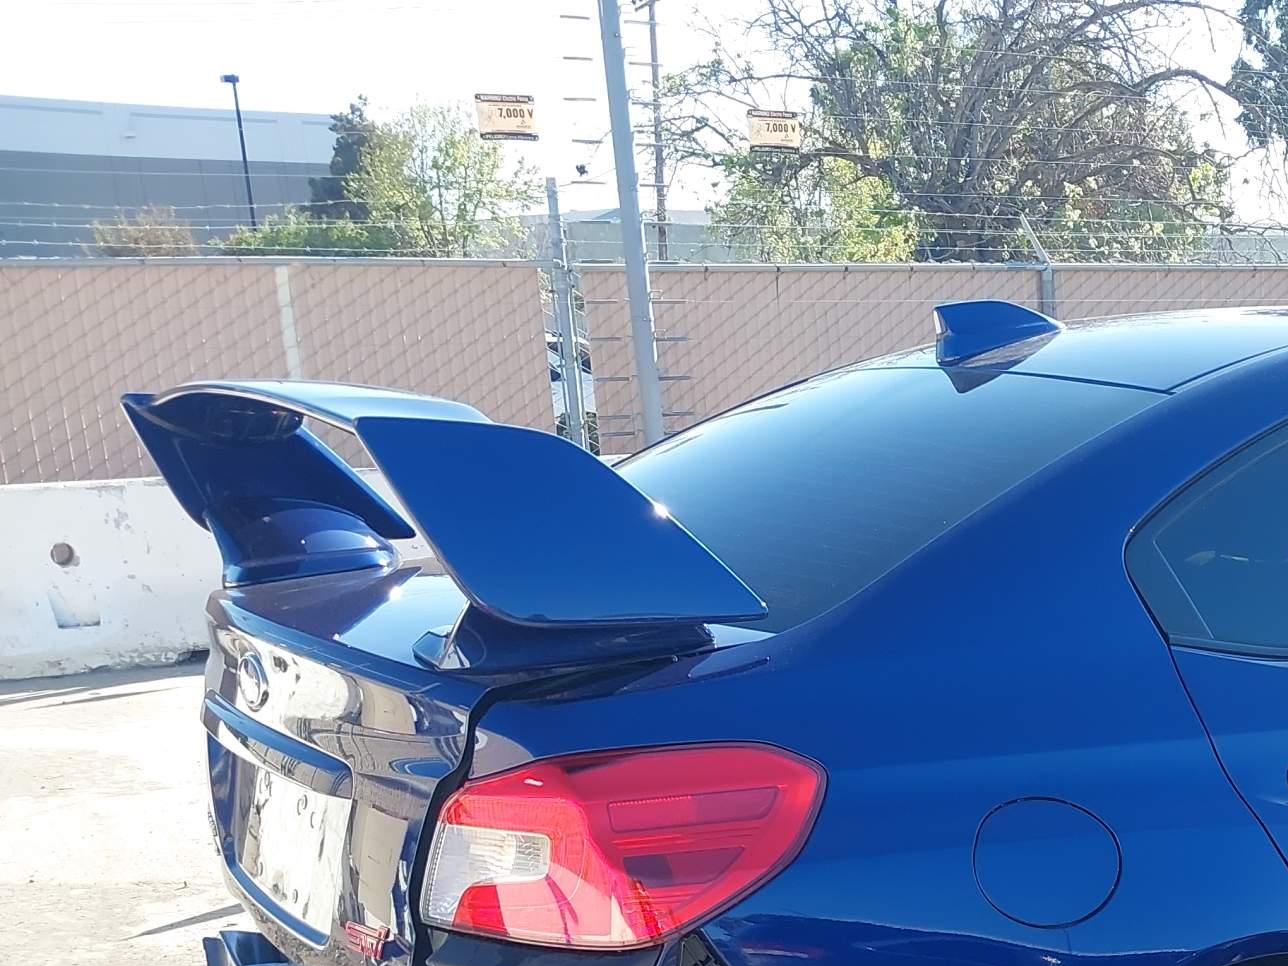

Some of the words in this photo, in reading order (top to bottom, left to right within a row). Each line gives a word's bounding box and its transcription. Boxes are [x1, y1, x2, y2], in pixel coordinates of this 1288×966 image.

[497, 107, 525, 119] 7,000
[528, 108, 534, 119] V
[765, 122, 789, 133] 7,000
[791, 123, 796, 133] V
